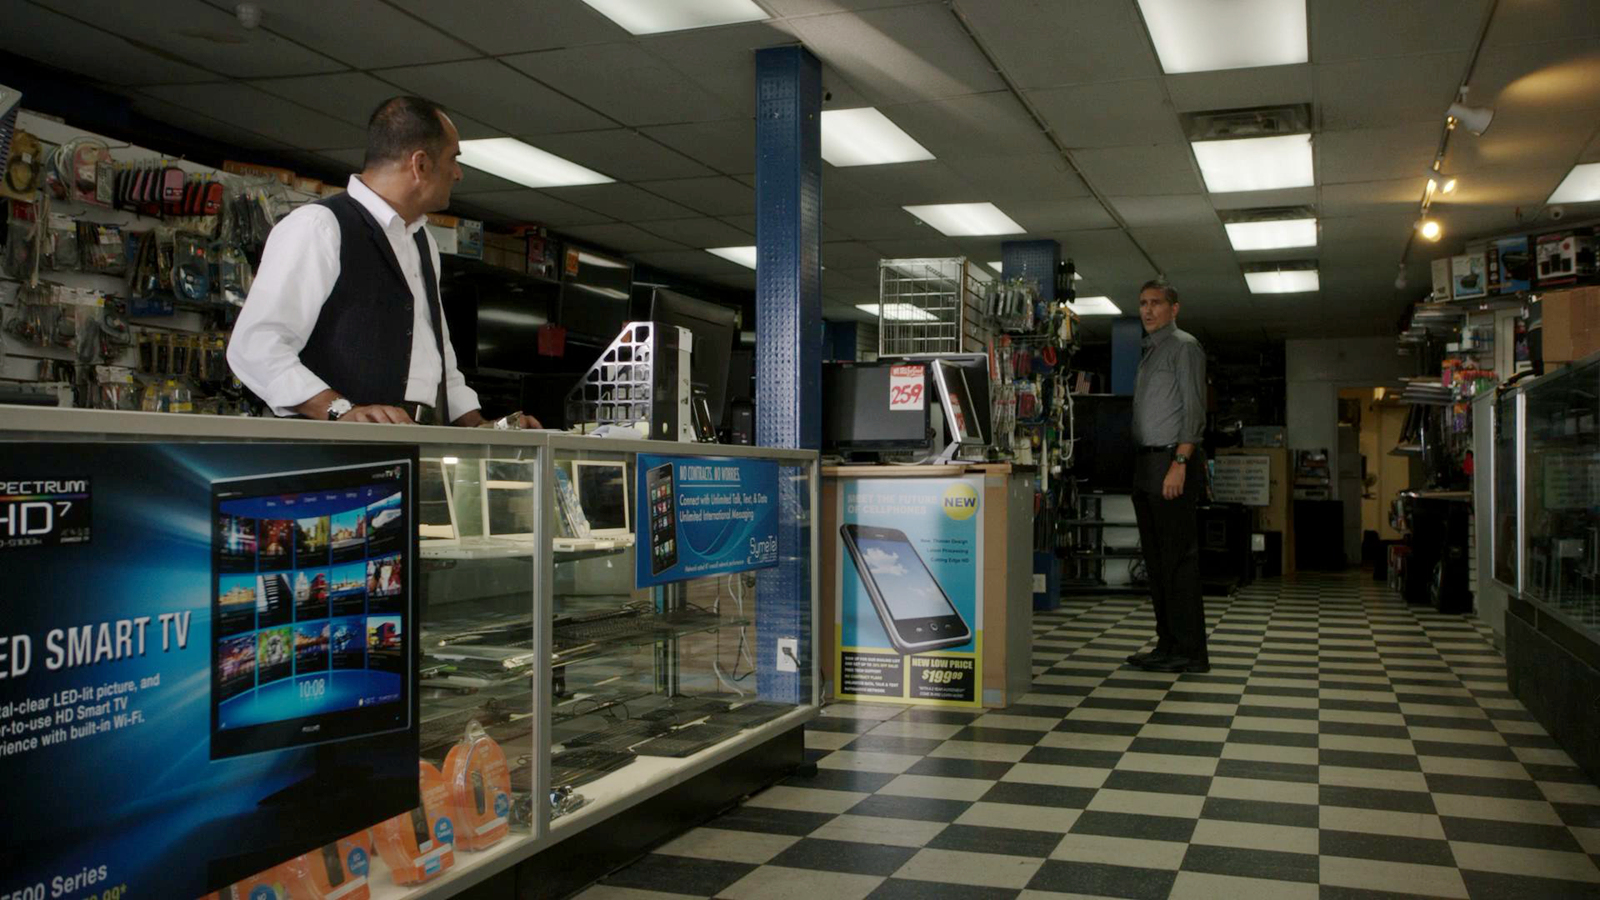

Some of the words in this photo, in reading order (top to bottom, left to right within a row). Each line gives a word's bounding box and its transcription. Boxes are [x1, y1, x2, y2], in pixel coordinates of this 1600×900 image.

[891, 383, 923, 405] 259
[679, 493, 700, 506] Connect
[700, 493, 710, 505] with
[711, 492, 732, 505] Unlimited
[877, 493, 894, 504] THE
[898, 494, 938, 505] FUTURE
[944, 497, 976, 508] NEW
[679, 509, 702, 523] Unlimited
[847, 504, 861, 514] OF
[863, 505, 927, 515] CELLPHONES
[45, 616, 151, 670] SMART
[158, 610, 192, 652] TV
[911, 658, 930, 667] NEW
[930, 659, 949, 668] LOW
[949, 660, 973, 670] PRICE
[53, 685, 95, 707] LED-lit
[96, 682, 138, 702] picture,
[140, 673, 161, 688] and
[299, 678, 325, 698] 10:08
[0, 714, 52, 737] r-to-use
[55, 708, 74, 725] HD
[77, 702, 111, 720] Smart
[113, 696, 129, 710] TV
[41, 729, 67, 746] with
[70, 719, 111, 740] built-in
[113, 710, 146, 730] Wi-Fi.
[51, 864, 108, 898] Series
